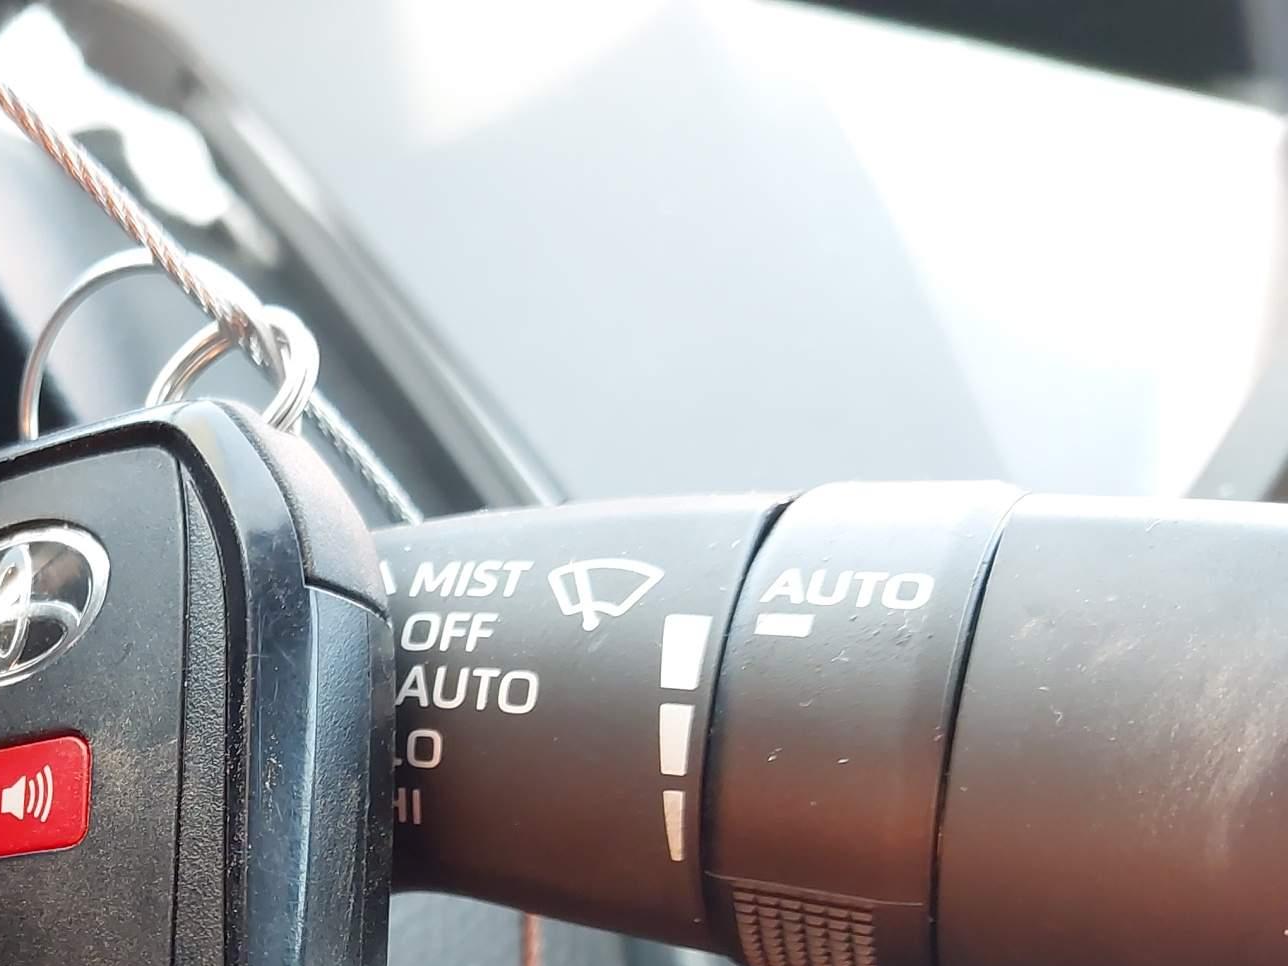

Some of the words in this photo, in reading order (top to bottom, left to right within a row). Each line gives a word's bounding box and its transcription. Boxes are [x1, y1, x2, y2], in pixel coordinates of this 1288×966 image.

[408, 561, 534, 599] MIST
[758, 568, 936, 610] AUTO
[400, 611, 501, 653] OFF
[395, 663, 540, 714] AUTO
[393, 728, 443, 769] O
